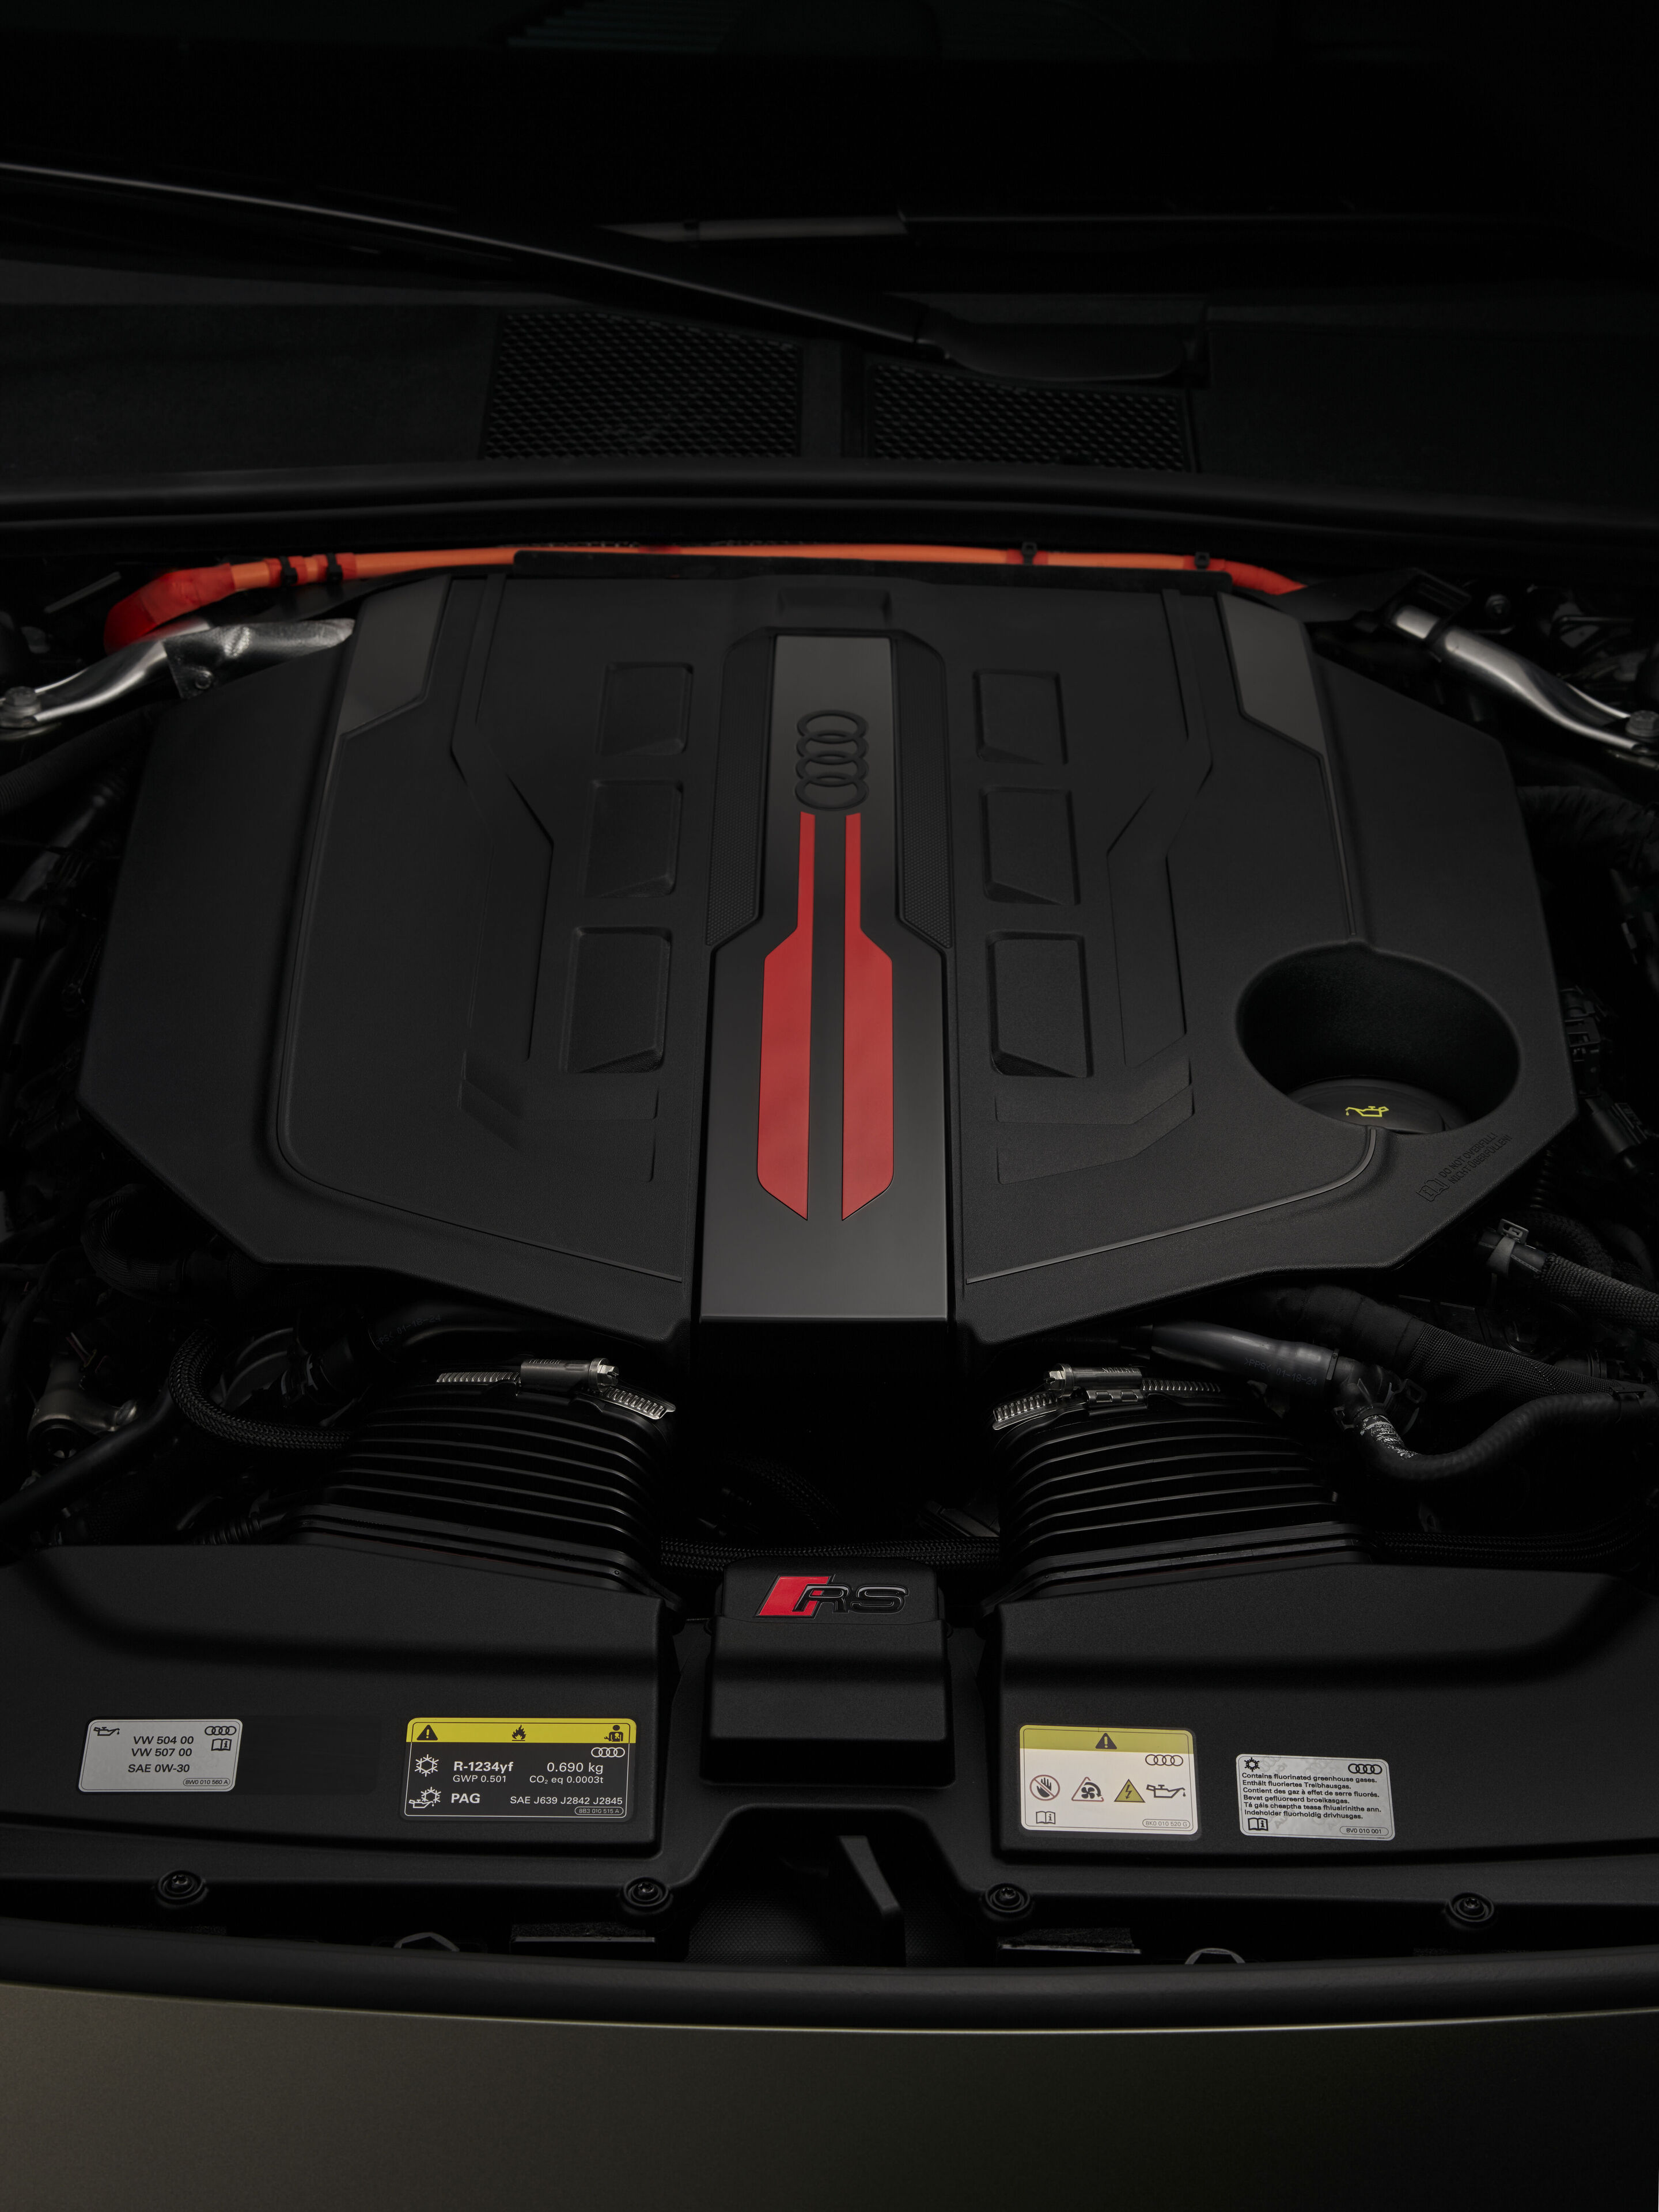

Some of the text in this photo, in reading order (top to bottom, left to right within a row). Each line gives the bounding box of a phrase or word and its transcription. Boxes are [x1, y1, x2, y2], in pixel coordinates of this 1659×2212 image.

[1438, 1132, 1498, 1178] DO NOT OVERFILL!
[1448, 1165, 1471, 1184] NICHT
[1276, 1368, 1319, 1387] 01-18-24
[791, 1583, 910, 1614] RS
[133, 1736, 194, 1744] VW 504 00
[131, 1748, 192, 1756] VW 507 00
[128, 1764, 190, 1773] SAE 0W-30
[453, 1761, 514, 1774] R-1234yf
[547, 1762, 604, 1775] 0.690 kg
[453, 1775, 506, 1783] GWP 0.501
[551, 1777, 563, 1785] eq
[566, 1775, 604, 1784] 0.0003t
[1304, 1782, 1351, 1790] Treibhausgas.
[451, 1793, 480, 1804] PAG
[510, 1796, 623, 1805] SAE J639 J2842 J2845
[1283, 1811, 1321, 1819] fluorholdig
